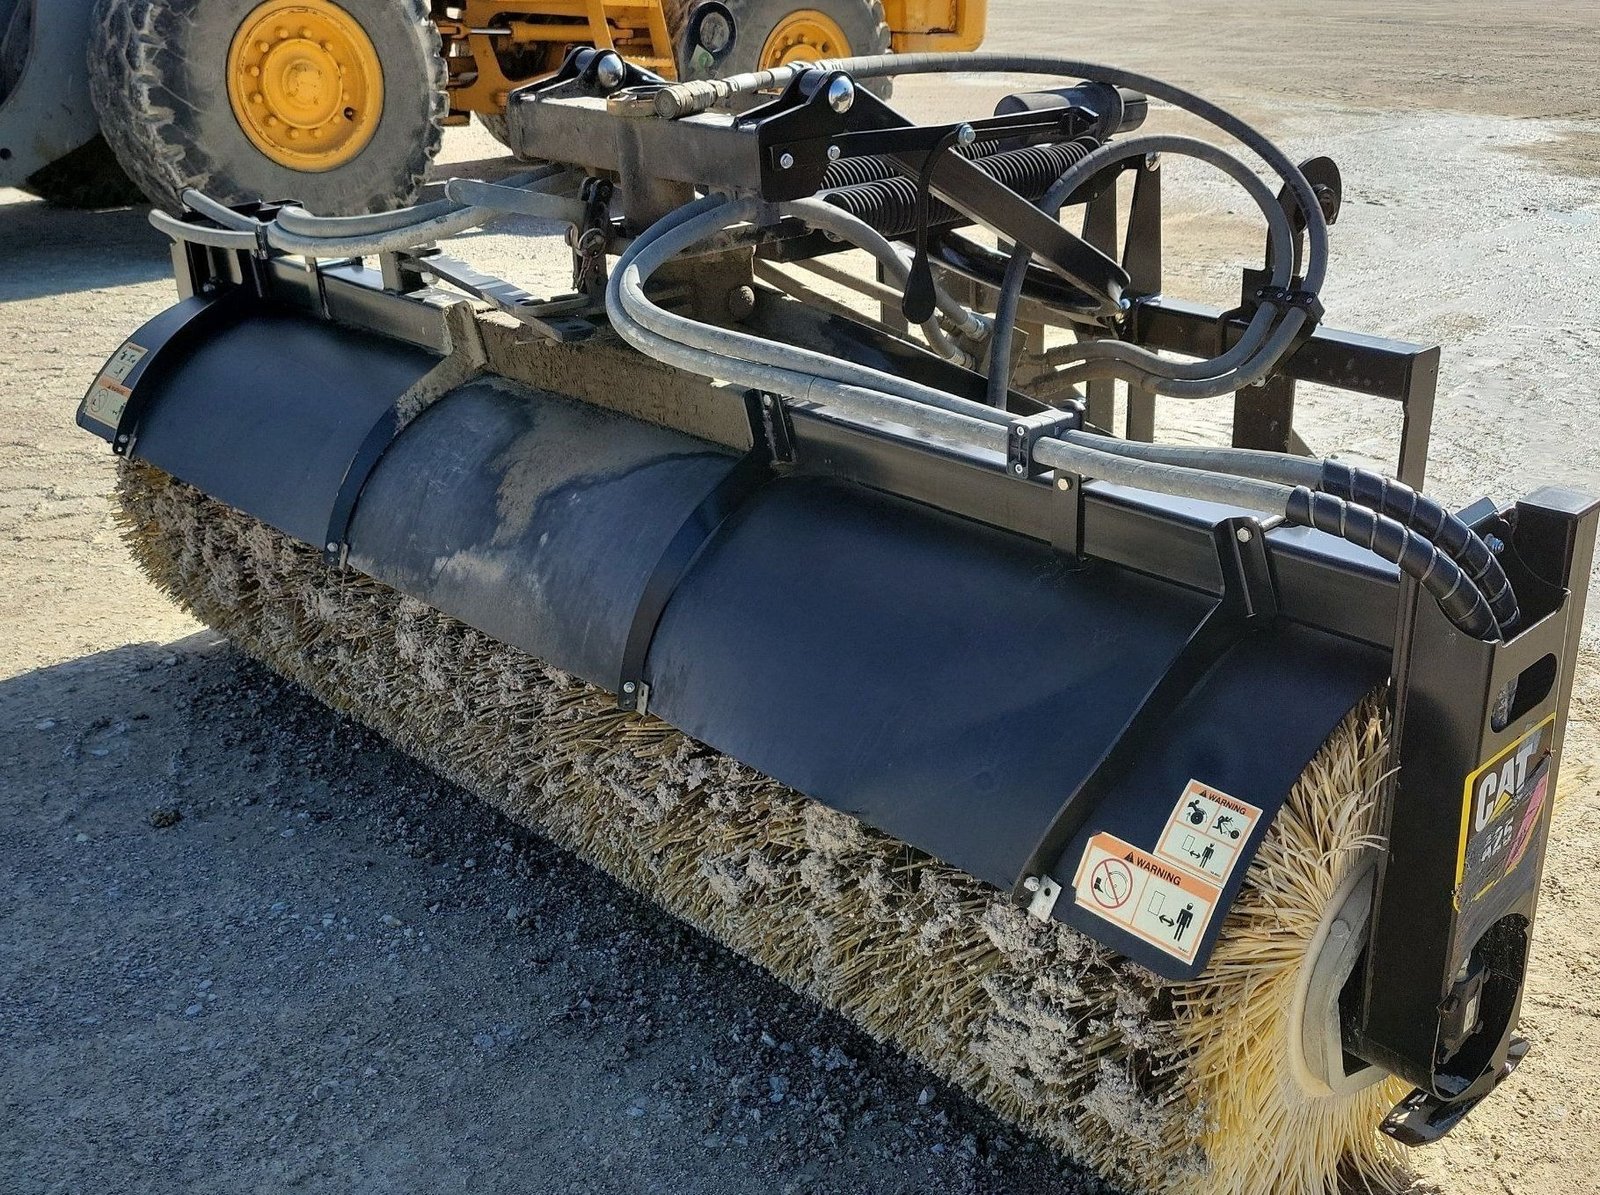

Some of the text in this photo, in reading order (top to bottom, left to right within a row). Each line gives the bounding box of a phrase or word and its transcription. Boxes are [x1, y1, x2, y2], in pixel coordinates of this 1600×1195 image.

[1475, 743, 1534, 832] CAT
[1208, 793, 1247, 815] WARNING
[1136, 856, 1182, 886] WARNING
